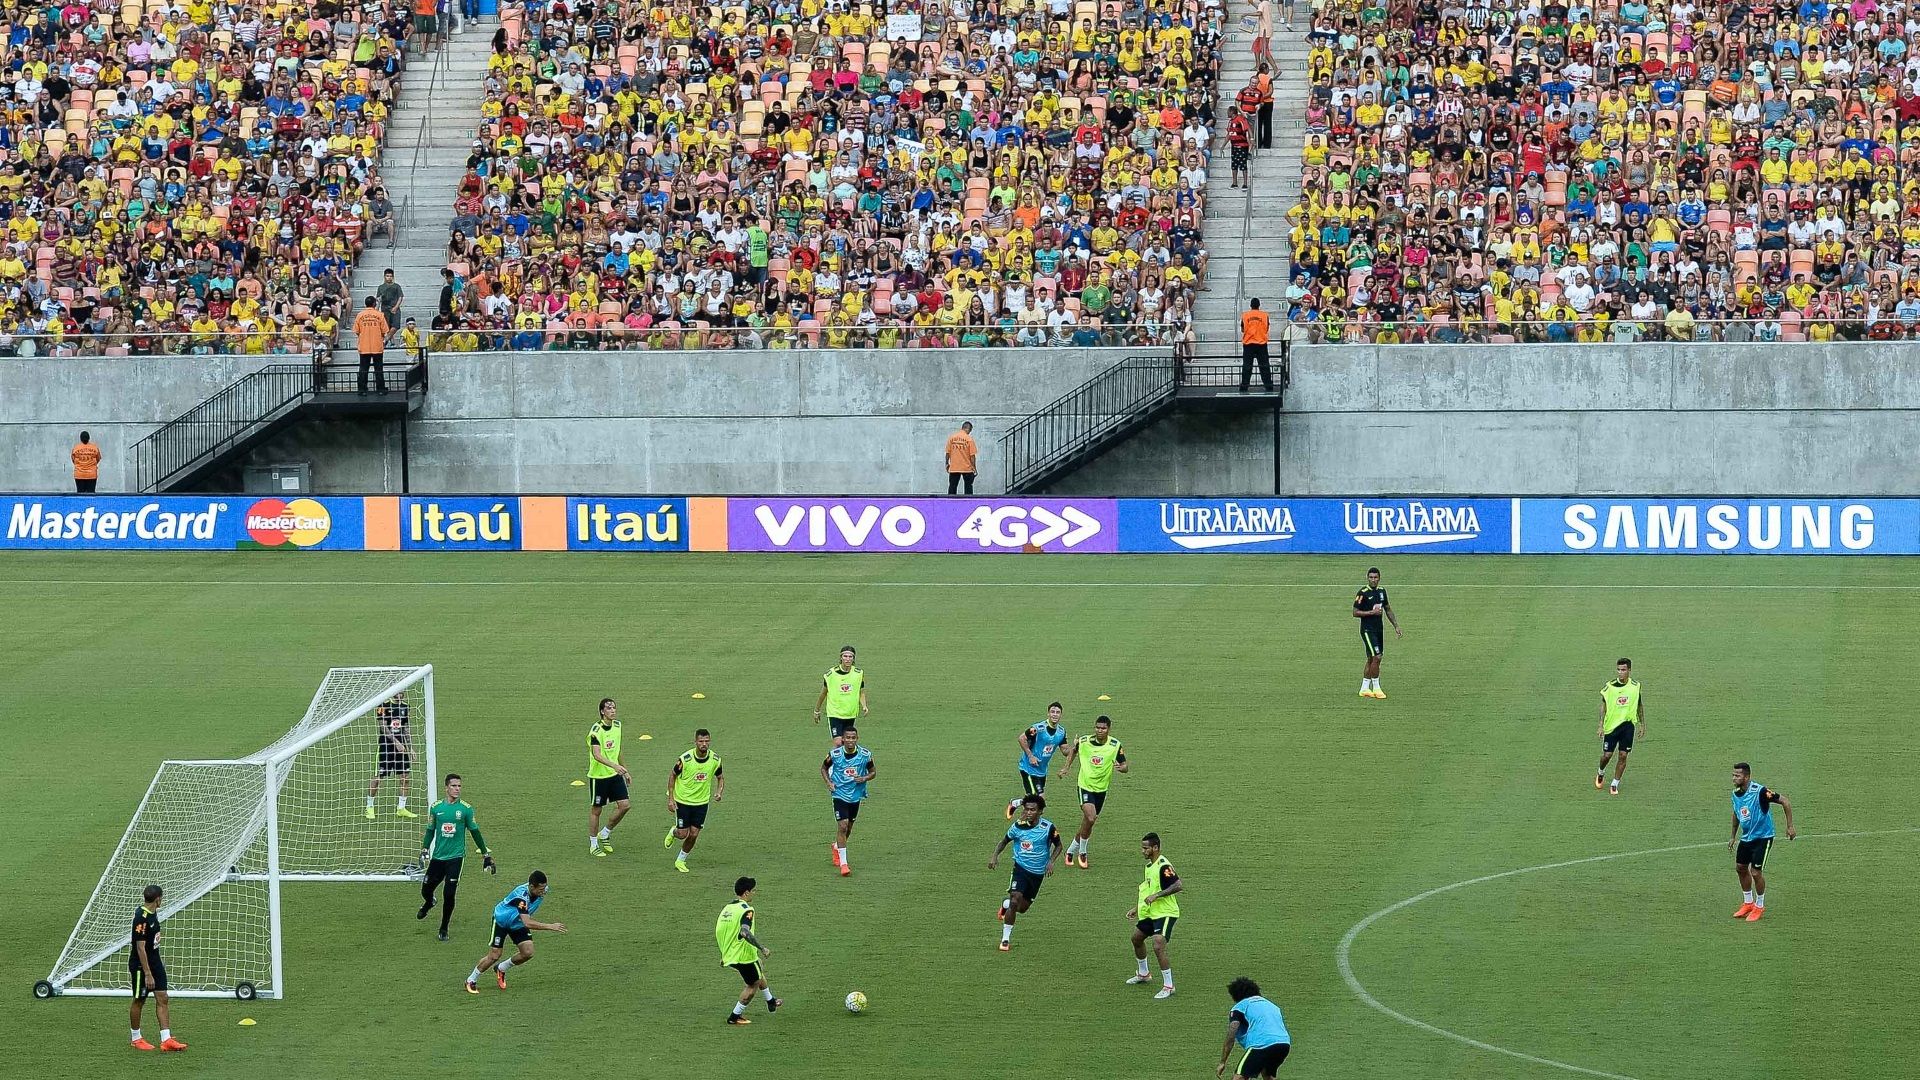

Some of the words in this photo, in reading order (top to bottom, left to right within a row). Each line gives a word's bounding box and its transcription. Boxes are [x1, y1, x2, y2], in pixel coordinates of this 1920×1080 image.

[246, 514, 329, 532] MasterCard
[410, 503, 511, 541] Itaú
[577, 504, 680, 542] Itaú
[754, 504, 926, 547] VIVO
[1563, 503, 1875, 551] SAMSUNG
